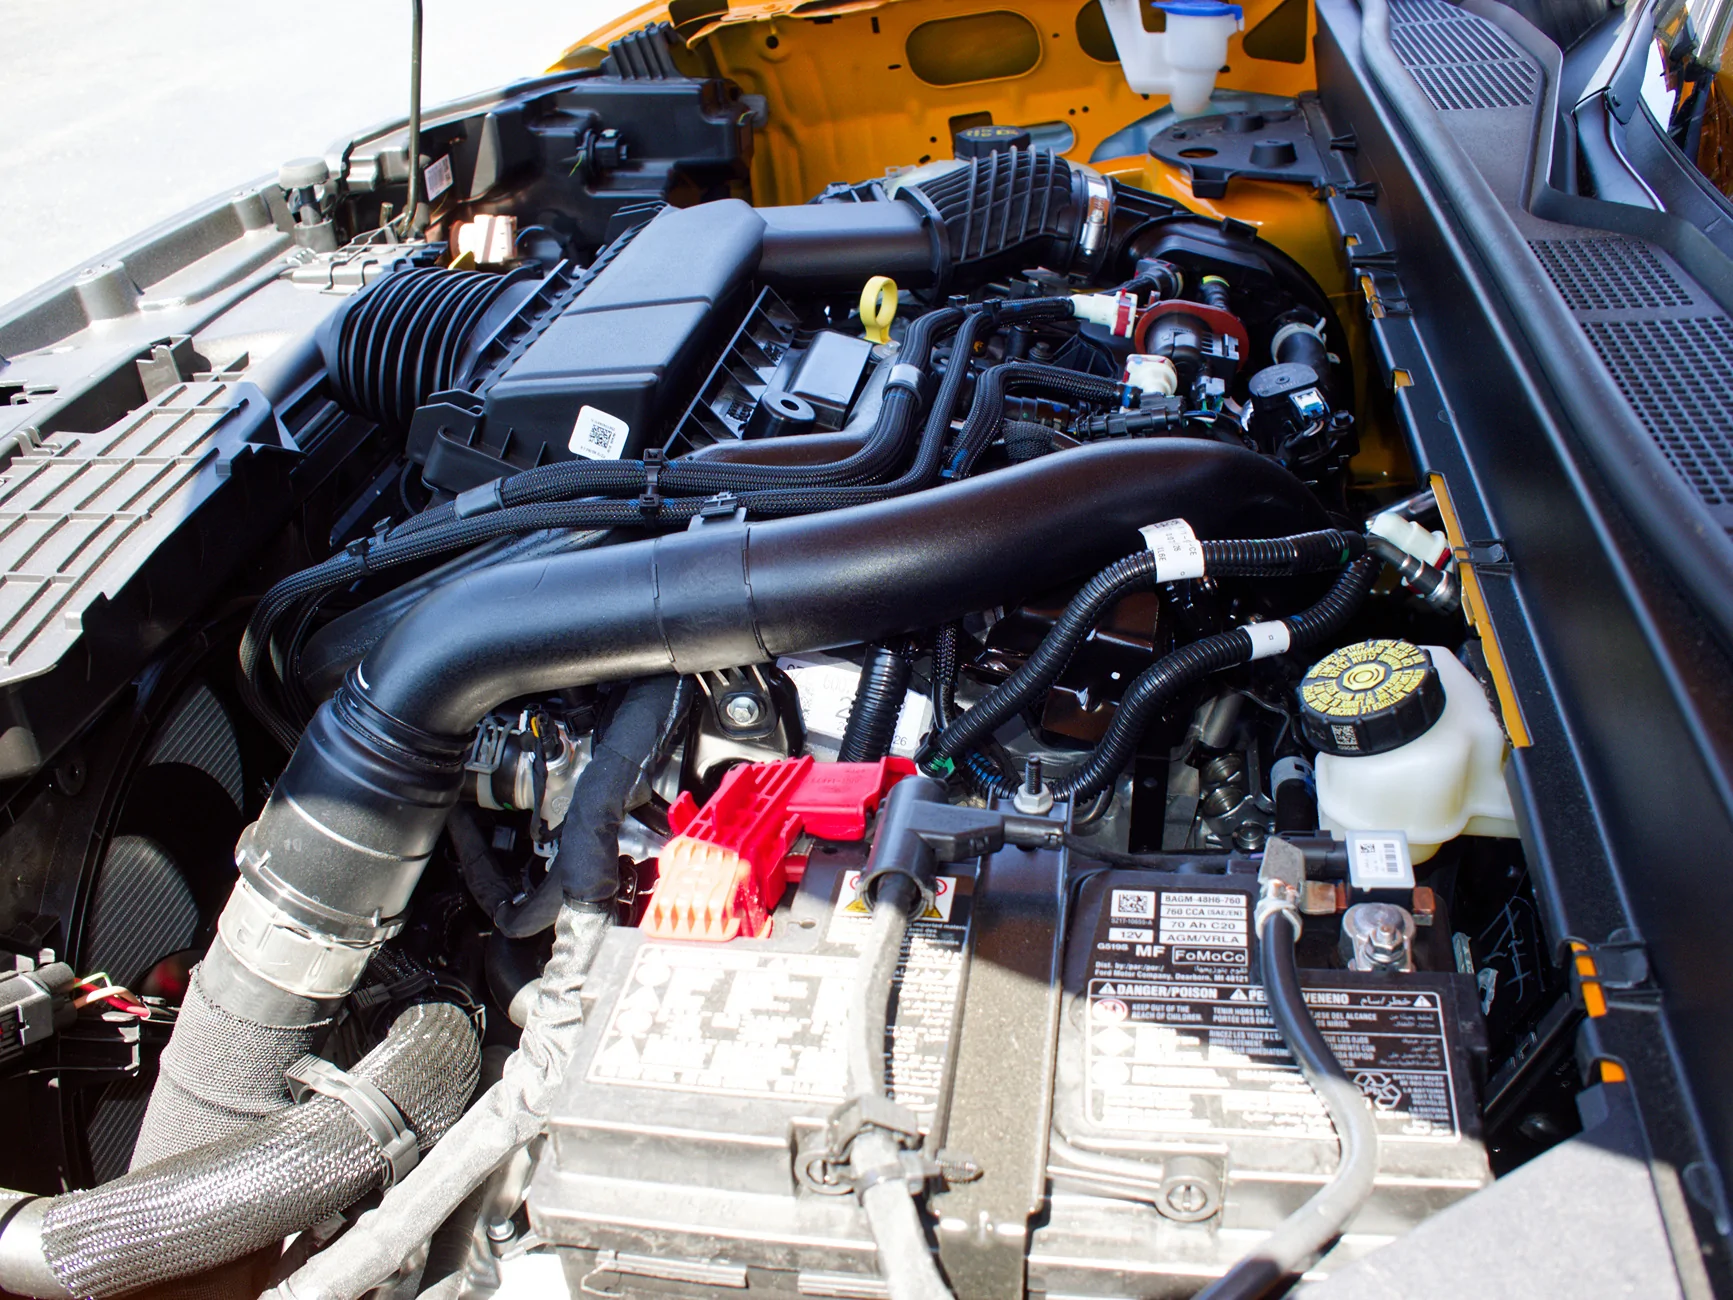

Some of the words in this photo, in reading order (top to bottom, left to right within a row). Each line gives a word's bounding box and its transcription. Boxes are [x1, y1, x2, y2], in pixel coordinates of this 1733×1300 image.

[1350, 653, 1376, 665] CLEAN
[1185, 908, 1205, 916] CCA
[1171, 921, 1185, 929] 70
[1190, 921, 1207, 929] Ah
[1211, 922, 1236, 930] C20
[1121, 931, 1143, 939] 12V
[1167, 934, 1240, 944] AGM/VRLA
[1135, 944, 1166, 958] MF
[1175, 949, 1246, 963] FoMoCo
[1094, 969, 1112, 977] Ford
[1113, 970, 1135, 978] Motor
[1175, 973, 1212, 982] Dearborn,
[1214, 974, 1224, 982] MI
[1117, 984, 1218, 999] DANGER/POISON
[1132, 1003, 1150, 1012] KEEP
[1151, 1004, 1162, 1012] OUT
[1164, 1005, 1175, 1013] OF
[1176, 1005, 1190, 1013] THE
[1213, 1006, 1234, 1015] TENIR
[1234, 1008, 1254, 1016] HORS
[1255, 1008, 1266, 1017] DE
[1131, 1011, 1154, 1020] REACH
[1155, 1012, 1166, 1020] OF
[1331, 1012, 1345, 1021] DEL
[1346, 1013, 1378, 1021] ALCANCE
